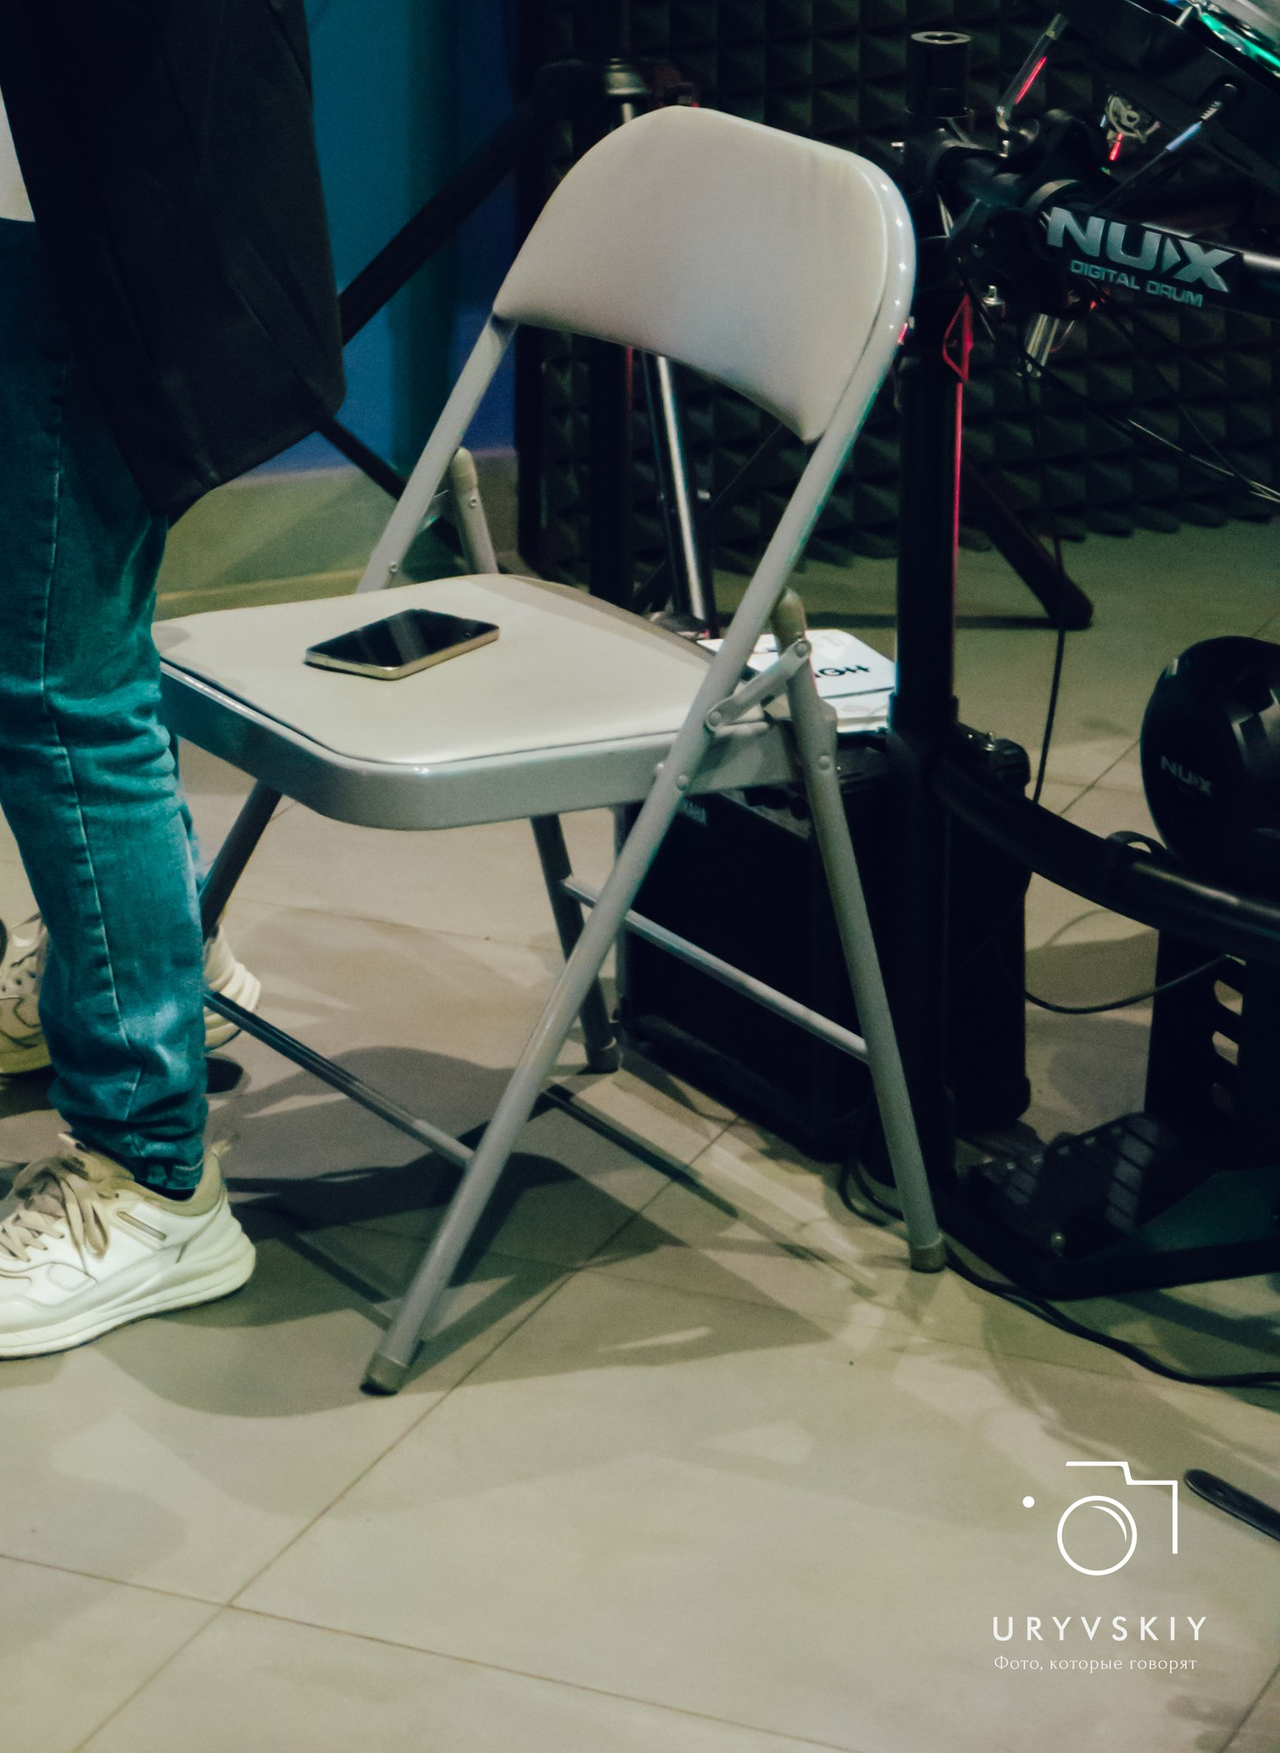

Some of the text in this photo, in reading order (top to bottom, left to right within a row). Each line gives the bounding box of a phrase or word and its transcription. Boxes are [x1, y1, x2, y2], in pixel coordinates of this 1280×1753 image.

[1047, 206, 1236, 293] NUX
[1070, 259, 1204, 308] DIGITAL DRUM
